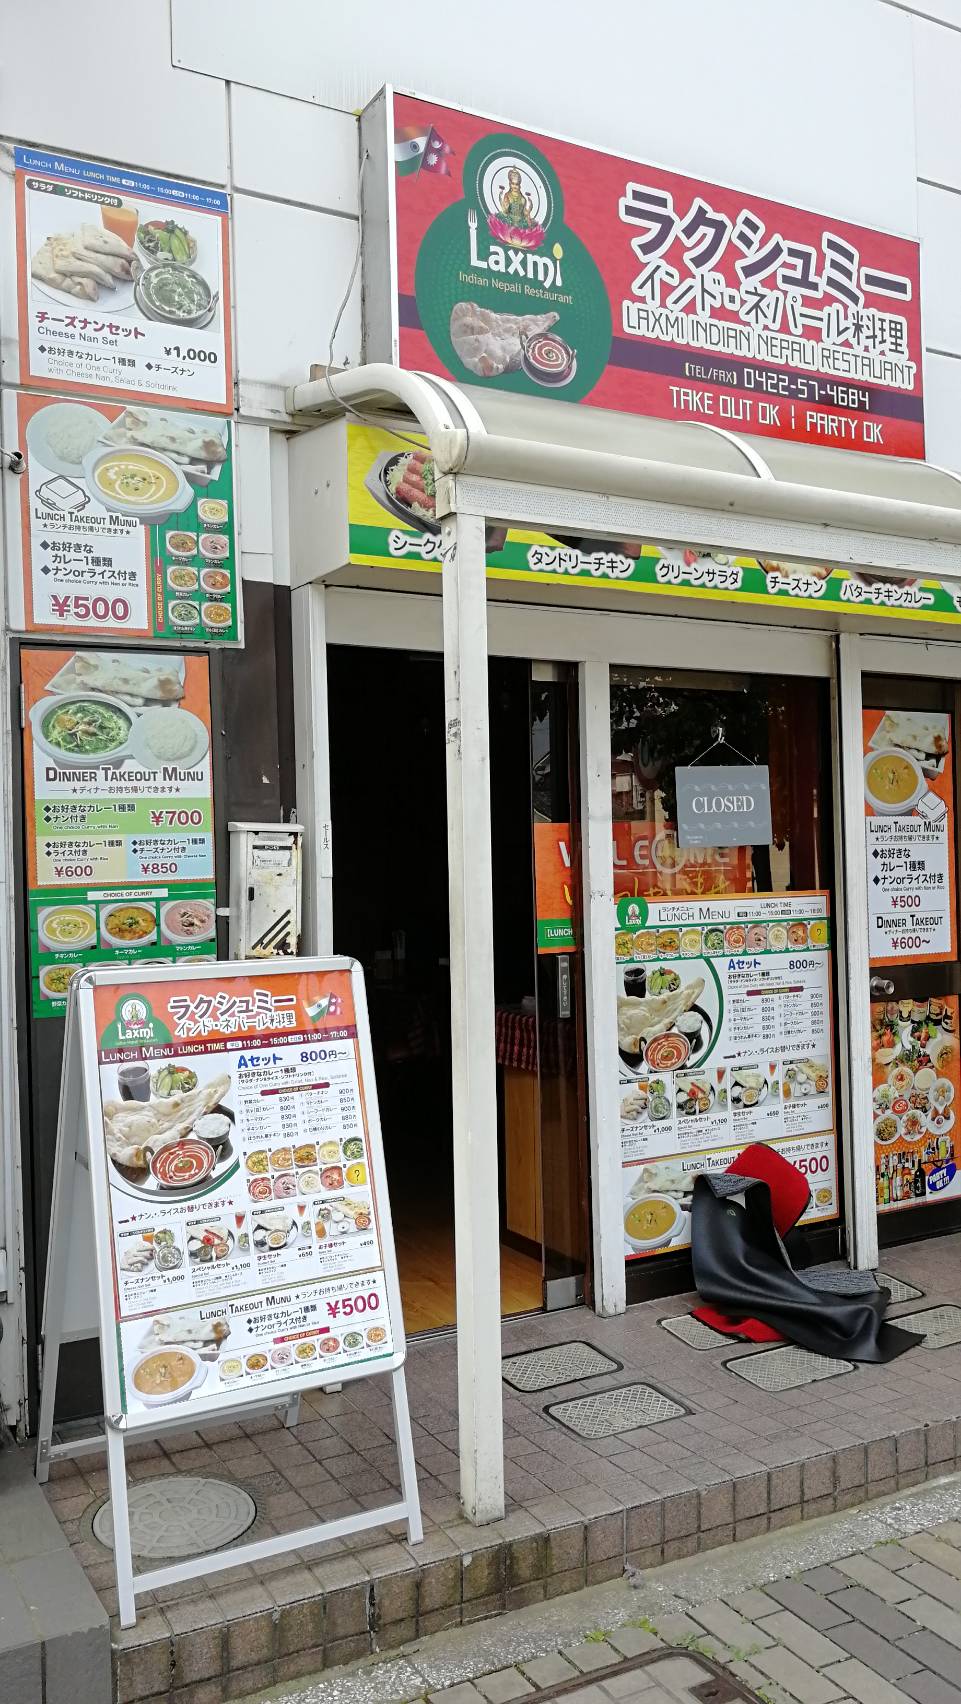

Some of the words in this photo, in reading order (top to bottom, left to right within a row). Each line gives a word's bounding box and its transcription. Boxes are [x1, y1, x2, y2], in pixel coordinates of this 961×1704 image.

[55, 161, 80, 174] MENU
[83, 170, 104, 180] LUNCH
[106, 175, 120, 183] TIME
[32, 181, 54, 192] サラダ
[468, 208, 563, 288] Laxmi
[623, 188, 909, 306] ラクシュミー
[460, 272, 488, 286] Indian
[492, 278, 522, 293] Nepali
[524, 285, 574, 304] Restaurant
[637, 264, 905, 355] インド・ネパール料理
[36, 311, 146, 340] チーズナンセット
[37, 326, 76, 340] Cheese
[79, 332, 99, 344] Nan
[102, 337, 118, 347] Set
[626, 305, 686, 341] LAXMI
[691, 314, 751, 352] INDIAN
[757, 334, 816, 367] NEPALI
[821, 348, 915, 386] RESTAUANT
[47, 346, 136, 368] お好きなカレー1種類
[155, 364, 196, 377] チーズナン
[164, 346, 218, 364] ¥1,000
[744, 368, 870, 410] 0422-57-4684
[669, 386, 714, 414] TAKE
[720, 394, 752, 421] OUT
[758, 402, 780, 426] OK
[806, 411, 857, 440] PARTY
[863, 420, 884, 444] OK
[35, 508, 66, 522] LUNCH
[68, 512, 106, 524] TAKEOUT
[109, 515, 138, 528] MUNU
[50, 541, 94, 554] お好きな
[52, 554, 113, 568] カレー1種類
[52, 566, 138, 581] ナンorライス付き
[531, 550, 632, 575] タンドリーチキン
[658, 563, 740, 586] グリーンサラダ
[770, 576, 824, 594] チーズナン
[843, 584, 932, 605] バターチキンカレー
[51, 594, 129, 621] ¥500
[46, 766, 98, 782] DINNER
[102, 766, 158, 782] TAKEOUT
[162, 766, 204, 782] MUNU
[80, 786, 175, 794] ディナーお持ち帰りできます
[51, 804, 136, 813] お好きなカレー1種類
[692, 796, 754, 814] CLOSED
[52, 814, 86, 823] ナン付き
[151, 810, 202, 826] ¥700
[870, 821, 892, 832] LUNCH
[894, 821, 922, 832] TAKEOUT
[52, 840, 122, 848] お好きなカレー1種類
[138, 838, 205, 846] お好きなカレー1種類
[139, 846, 186, 854] チーズナン付き
[880, 848, 911, 859] お好きな
[54, 865, 94, 878] ¥600
[141, 862, 178, 874] ¥850
[880, 860, 926, 872] カレー1種類
[880, 873, 944, 886] ナンorライス付き
[891, 894, 921, 908] ¥500
[658, 910, 694, 922] LUNCH
[699, 907, 731, 920] MENU
[876, 916, 906, 928] DINNER
[910, 914, 943, 926] TAKEOUT
[728, 958, 762, 970] Aセット
[170, 990, 296, 1021] ラクシュミー
[117, 1022, 154, 1040] Laxmi
[176, 1014, 296, 1036] インド・ネパール料理
[102, 1050, 138, 1062] LUNCH
[142, 1046, 174, 1058] MENU
[178, 1045, 204, 1054] LUNCH
[206, 1043, 225, 1051] TIME
[243, 1040, 261, 1048] 11:00
[238, 1053, 283, 1069] Aセット
[238, 1067, 296, 1079] お好きなカレー1種類
[620, 1124, 656, 1133] チーズナンセット
[682, 1160, 705, 1172] LUNCH
[707, 1156, 735, 1168] TAKEOUT
[256, 1252, 282, 1262] 学生セット
[191, 1262, 230, 1274] スペシャルセット
[231, 1262, 250, 1271] ¥1,100
[124, 1274, 166, 1286] チーズナンセット
[162, 1274, 185, 1284] ¥1,000
[301, 1281, 372, 1299] ランチお持ち帰りできます
[200, 1308, 227, 1320] LUNCH
[228, 1300, 263, 1315] TAKEOUT
[266, 1295, 292, 1306] MUNU
[326, 1292, 380, 1318] ¥500
[252, 1304, 318, 1324] お好きなカレー1種類
[254, 1316, 308, 1333] ナンorライス付き
